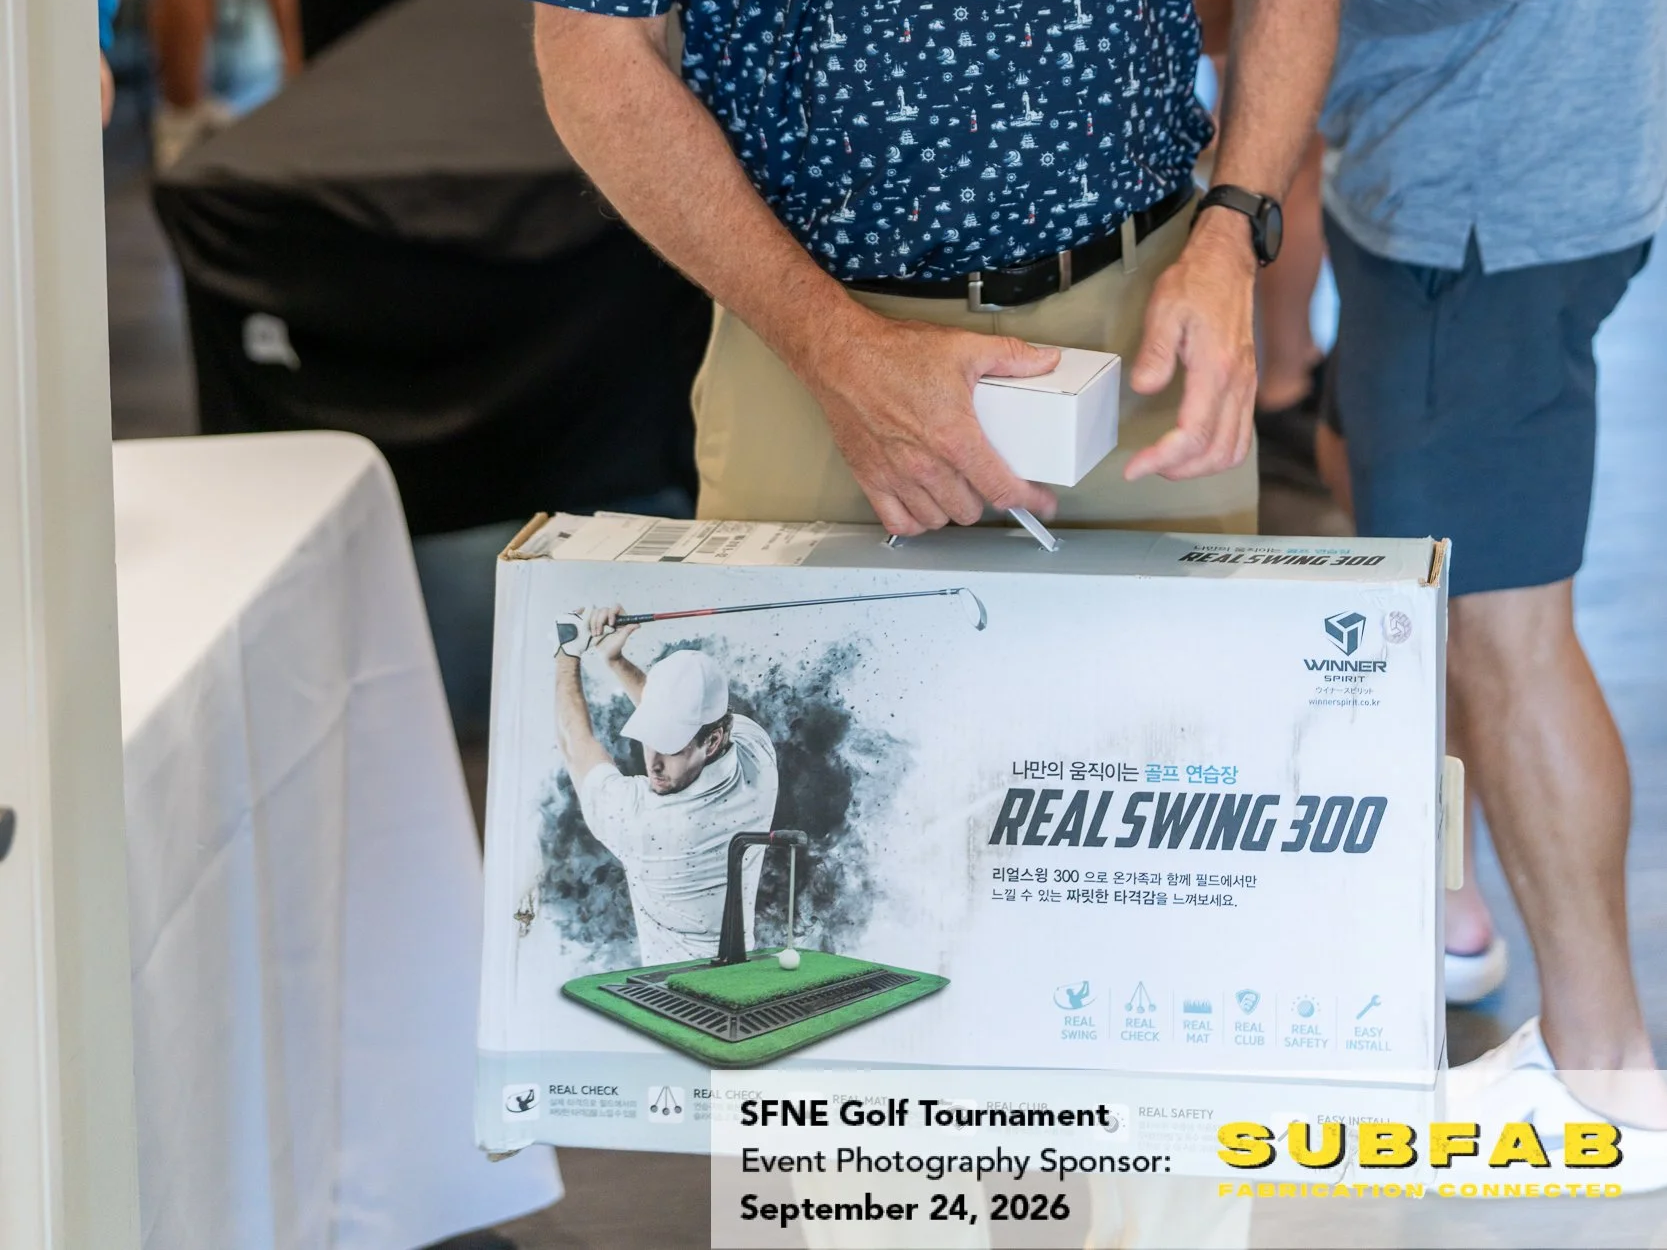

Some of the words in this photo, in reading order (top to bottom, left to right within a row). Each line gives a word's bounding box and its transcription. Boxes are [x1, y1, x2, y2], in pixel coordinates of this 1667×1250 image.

[1330, 555, 1386, 566] 300
[1303, 658, 1387, 672] WINNER
[1324, 675, 1365, 683] SPIRIT
[1308, 698, 1381, 708] winnerspirit.co.kr
[1012, 760, 1063, 781] 나만의
[1069, 761, 1139, 782] 움직이는
[1144, 763, 1180, 783] 골프
[1186, 764, 1239, 785] 연습장
[1281, 795, 1388, 854] 300
[992, 867, 1048, 883] 리얼스윙
[1054, 869, 1079, 883] 300
[1083, 871, 1108, 884] 으로
[1112, 871, 1162, 886] 온가족과
[1167, 872, 1191, 887] 함께
[1195, 873, 1257, 888] 필드에서만
[992, 888, 1016, 902] 느낄
[1020, 888, 1033, 902] 수
[1038, 889, 1062, 903] 있는
[1066, 888, 1109, 904] 짜릿한
[1114, 889, 1168, 906] 타격감을
[1173, 893, 1238, 908] 느껴보세요.
[1064, 1016, 1095, 1027] REAL
[1125, 1018, 1155, 1029] REAL
[1183, 1020, 1213, 1031] REAL
[1234, 1022, 1265, 1033] REAL
[1291, 1024, 1321, 1035] REAL
[1354, 1026, 1384, 1037] EASY
[1061, 1029, 1097, 1040] SWING
[1120, 1031, 1160, 1042] CHECK
[1186, 1033, 1210, 1043] MAT
[1234, 1035, 1265, 1046] CLUB
[1284, 1037, 1328, 1049] SAFETY
[1345, 1040, 1392, 1052] INSTALL
[549, 1085, 577, 1095] REAL
[582, 1086, 619, 1096] CHECK
[693, 1089, 721, 1099] REAL
[725, 1090, 763, 1101] CHECK
[864, 1096, 887, 1106] MAT
[1139, 1106, 1168, 1118] REAL
[1171, 1108, 1214, 1120] SAFETY
